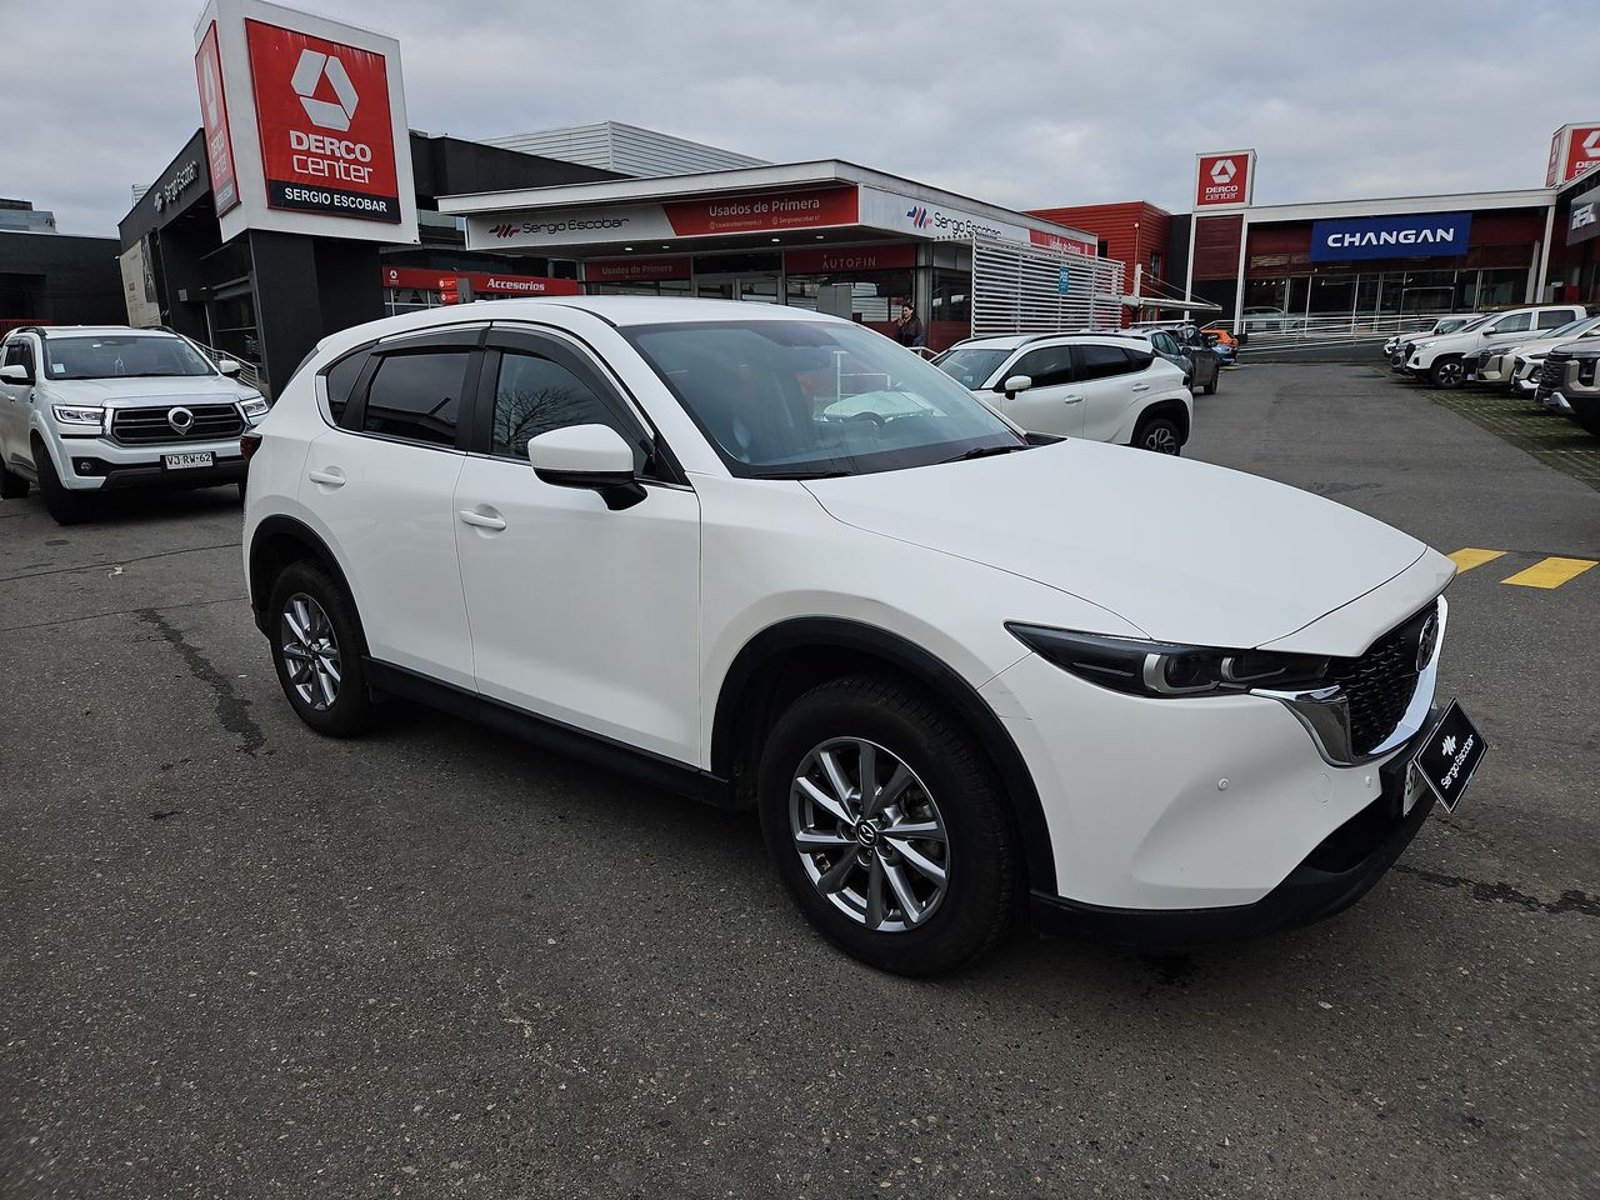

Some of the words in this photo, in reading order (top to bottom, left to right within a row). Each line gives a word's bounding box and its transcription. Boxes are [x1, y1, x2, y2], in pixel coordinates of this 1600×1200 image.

[289, 129, 372, 162] DERCO
[293, 154, 373, 184] center
[1205, 185, 1239, 194] DERCO
[284, 187, 331, 205] SERGIO
[333, 194, 387, 212] ESCOBAR
[709, 203, 751, 217] Usados
[753, 201, 769, 214] de
[771, 198, 820, 212] Primera
[568, 217, 630, 231] Escobar
[1326, 228, 1455, 248] CHANGAN
[822, 254, 876, 269] AUTOFIN
[487, 278, 545, 291] Accesorios
[1454, 734, 1474, 766] Escobar
